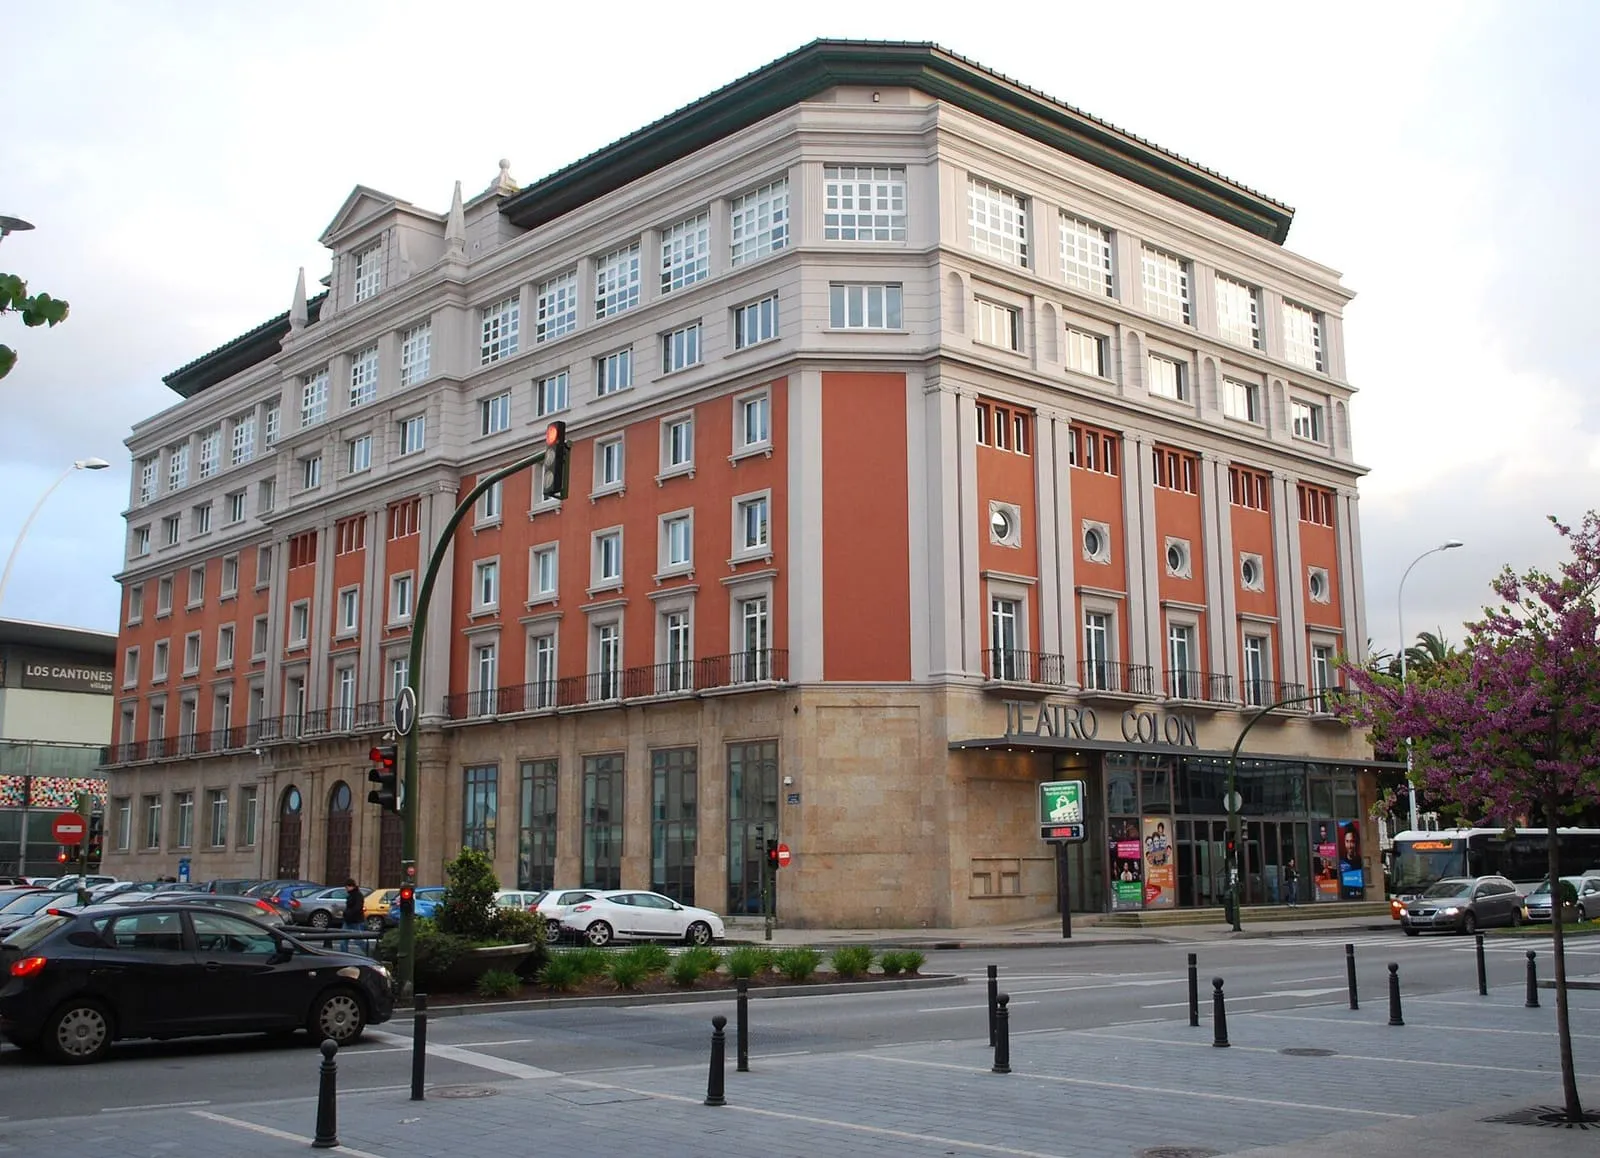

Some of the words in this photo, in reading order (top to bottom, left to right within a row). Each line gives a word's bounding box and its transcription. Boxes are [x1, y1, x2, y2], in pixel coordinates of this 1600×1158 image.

[26, 664, 49, 677] LOS
[52, 667, 113, 682] CANTONES
[90, 682, 113, 691] village
[1003, 700, 1098, 740] TEATRO
[1121, 710, 1197, 748] COLON
